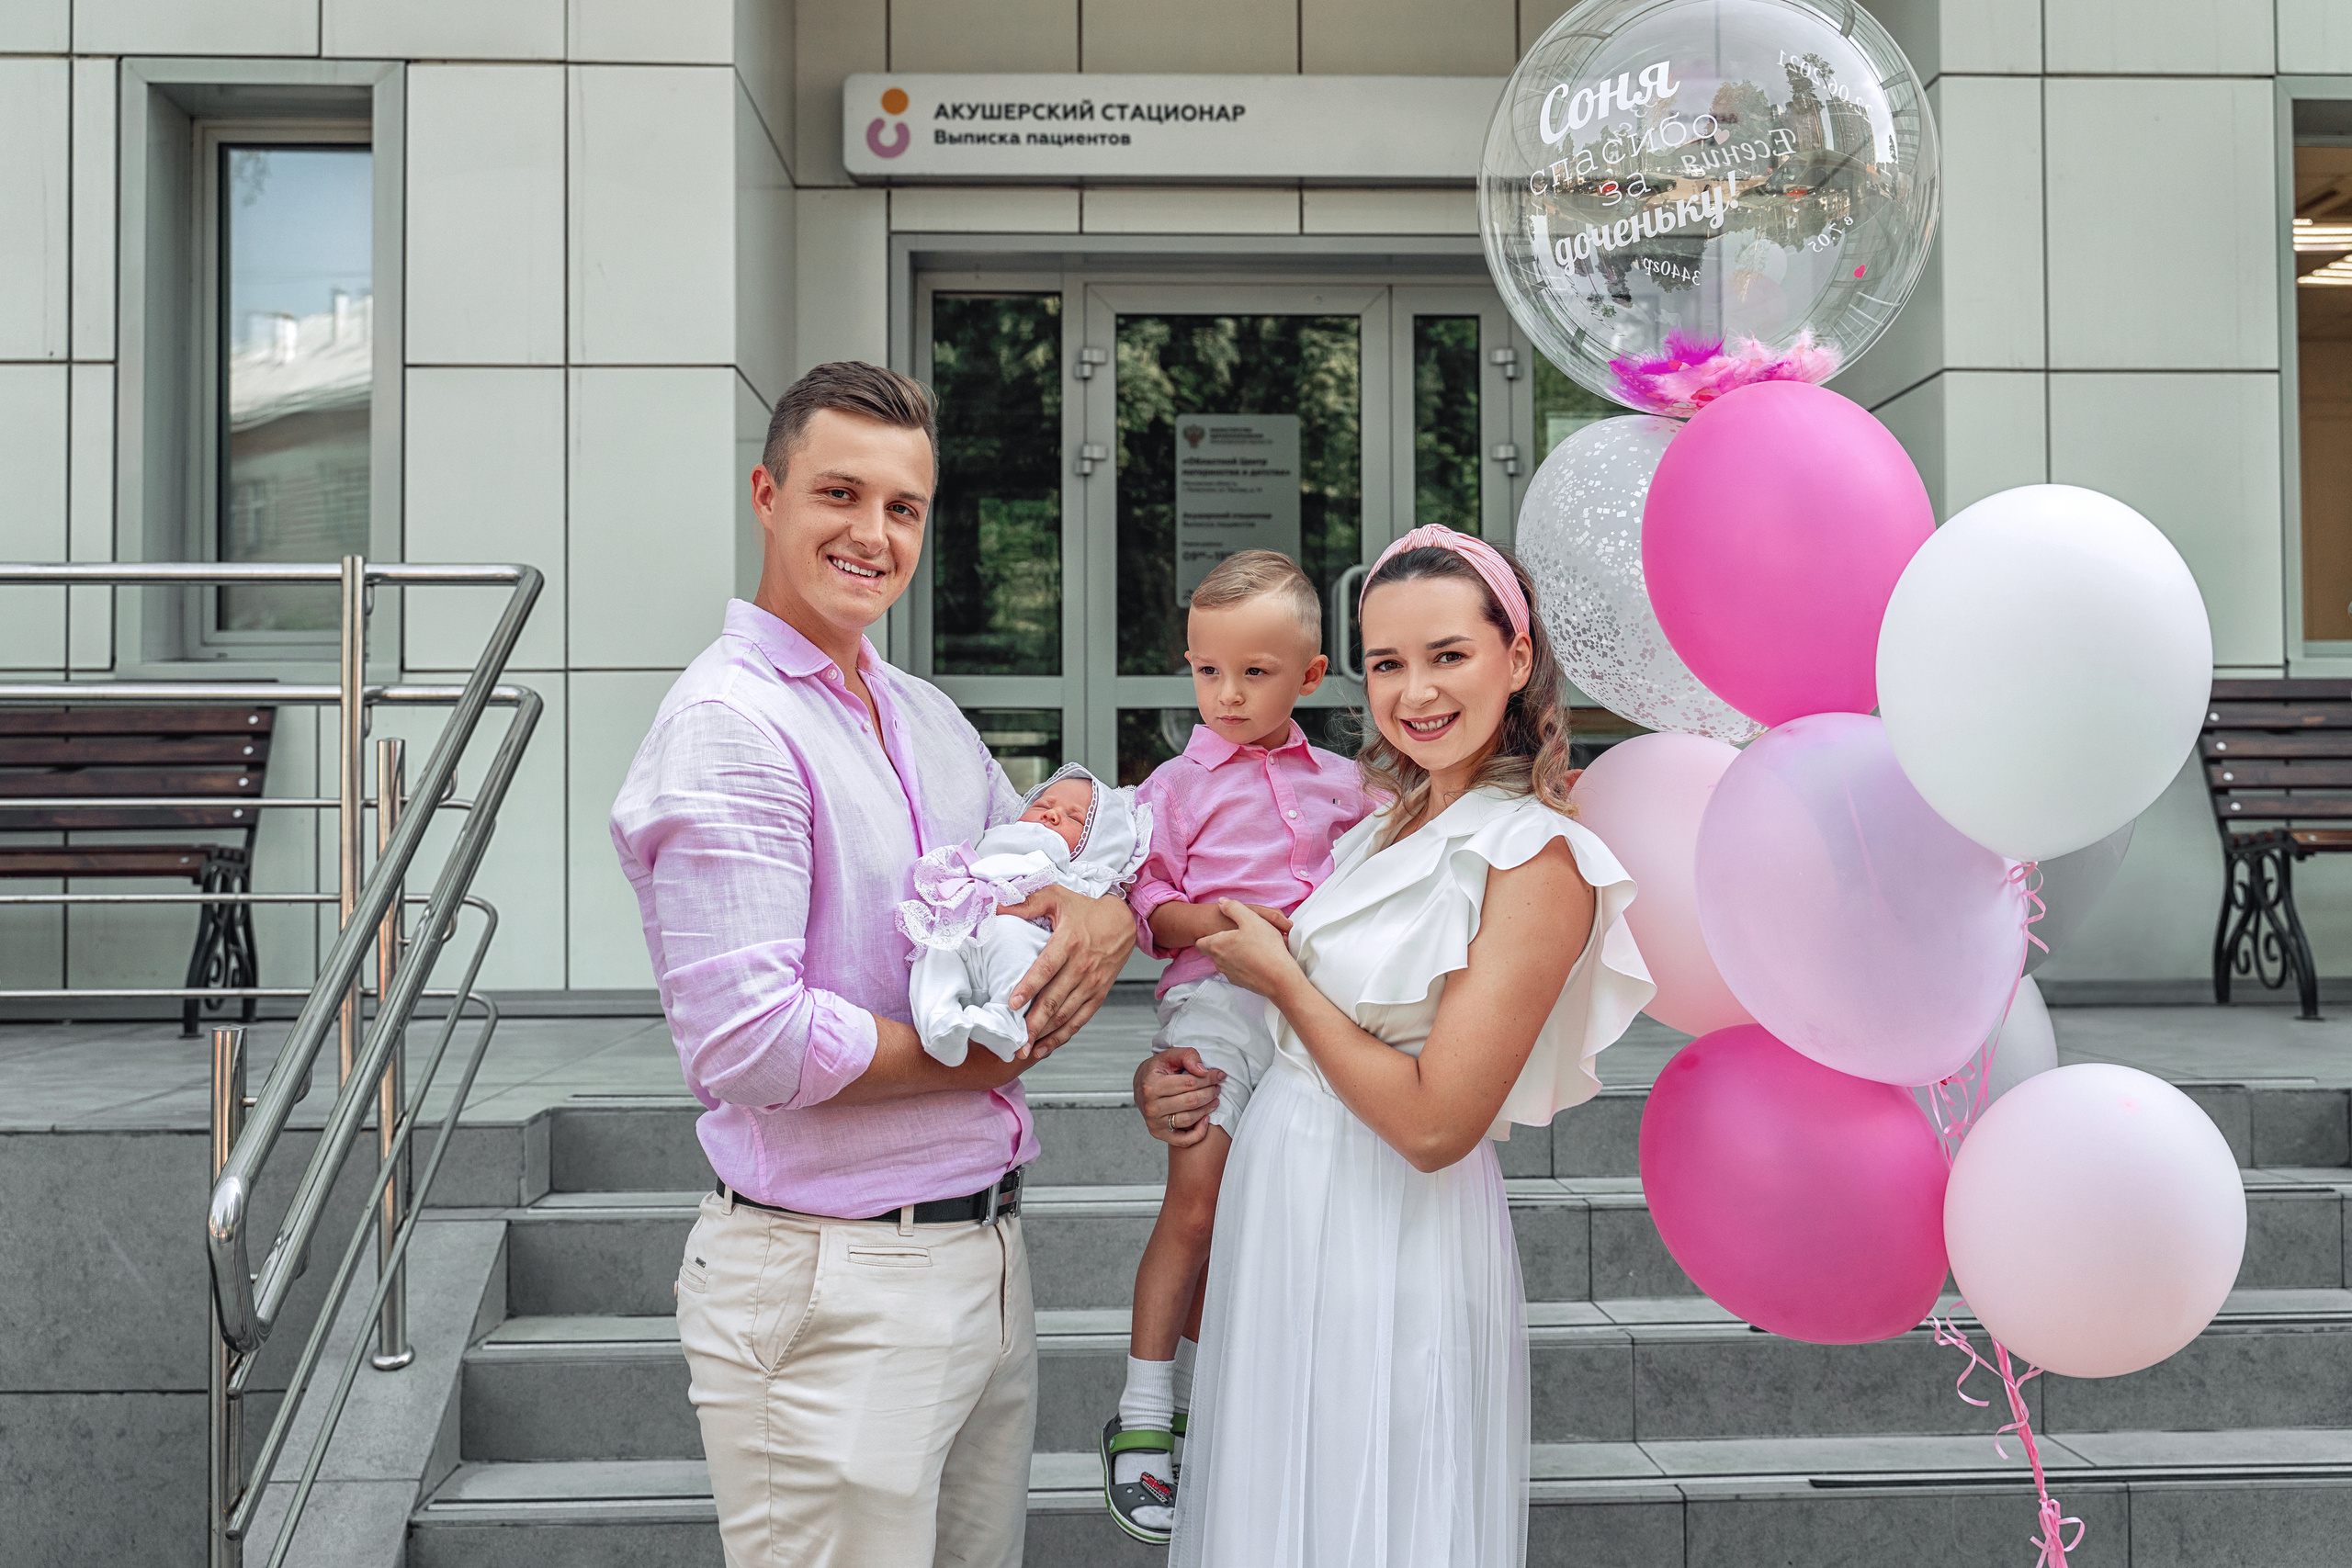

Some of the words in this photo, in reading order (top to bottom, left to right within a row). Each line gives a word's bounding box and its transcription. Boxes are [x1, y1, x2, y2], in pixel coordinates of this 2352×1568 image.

[934, 99, 1096, 122] АКУШЕРСКИЙ
[1102, 103, 1247, 123] СТАЦИОНАР
[1539, 60, 1680, 145] Соня
[933, 129, 1022, 147] Выписка
[1026, 133, 1132, 148] пациентов
[1530, 111, 1718, 196] спасибо
[1599, 172, 1651, 206] за
[1555, 170, 1739, 276] доченьку!
